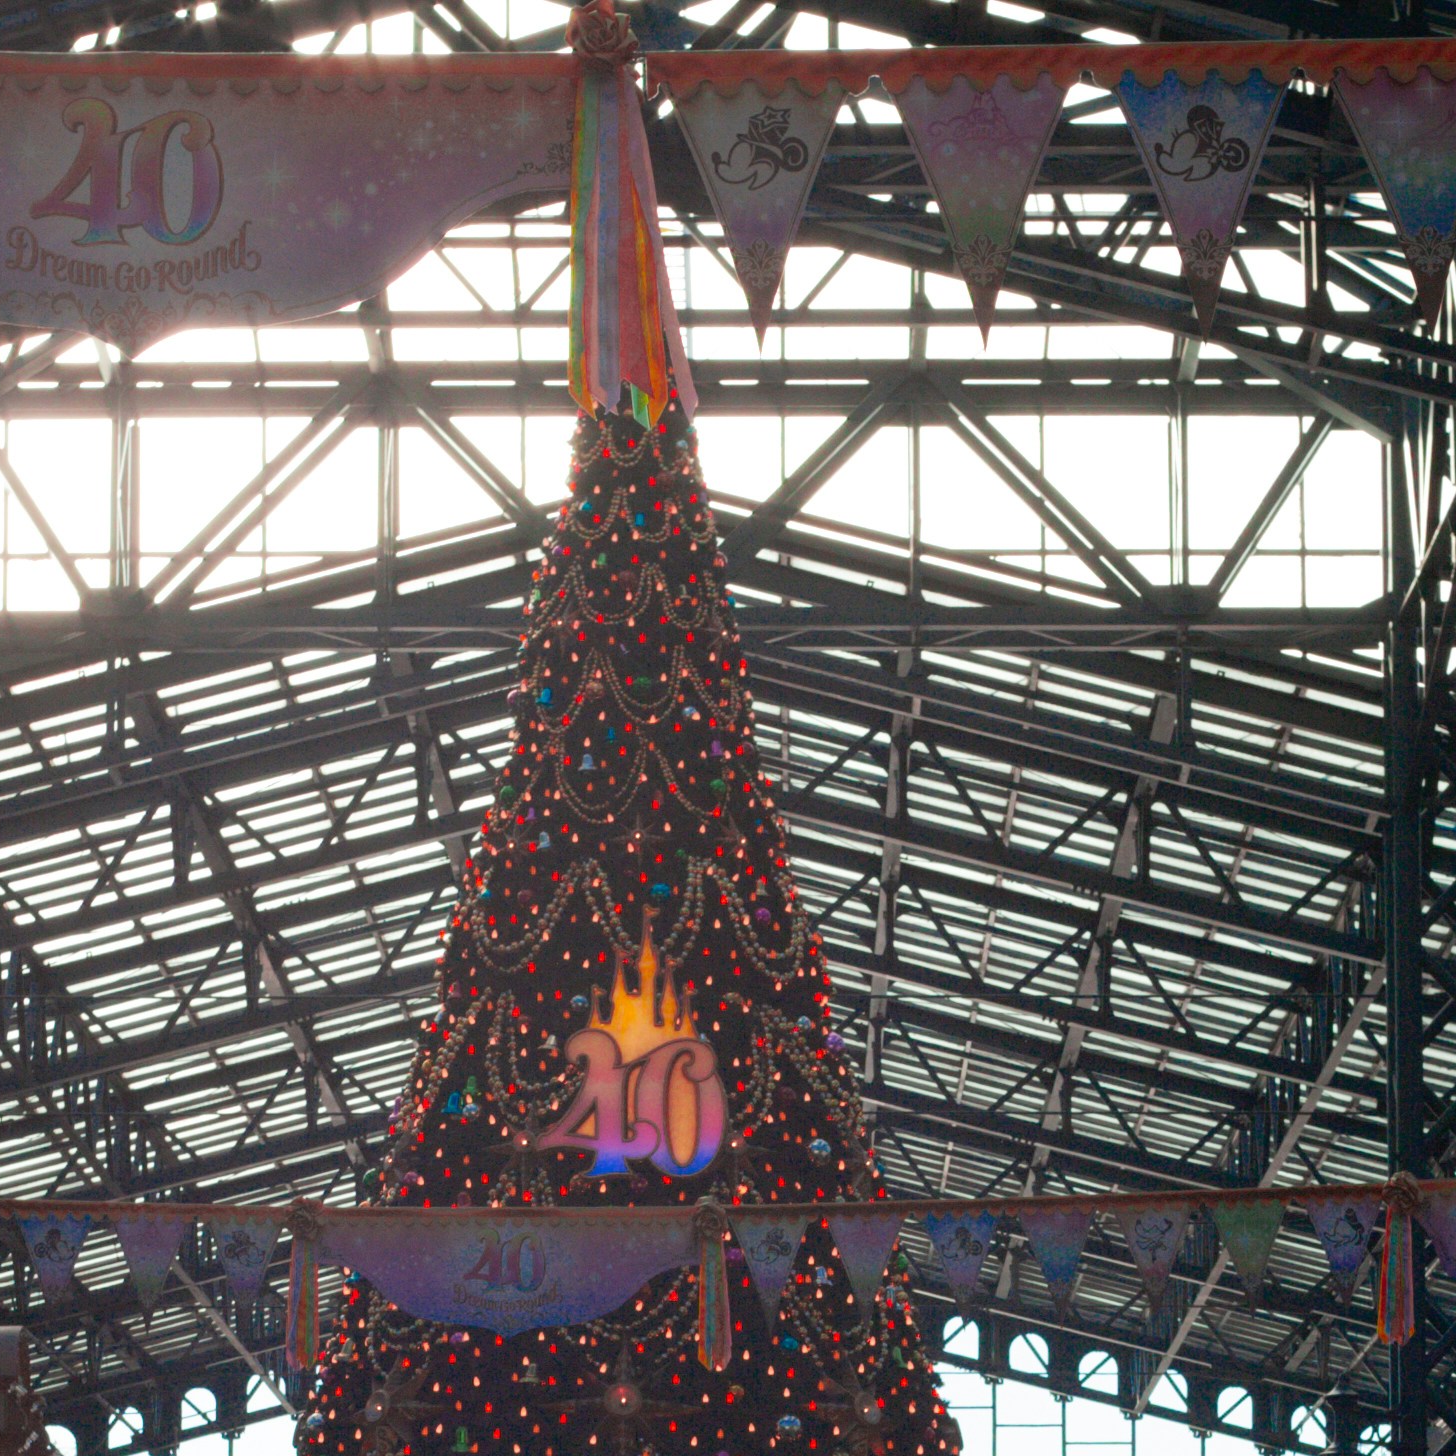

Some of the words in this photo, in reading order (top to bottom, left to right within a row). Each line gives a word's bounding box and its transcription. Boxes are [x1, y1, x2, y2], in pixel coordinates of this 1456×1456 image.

[29, 96, 224, 247] 40
[536, 1027, 729, 1178] 40
[462, 1227, 547, 1293] 40
